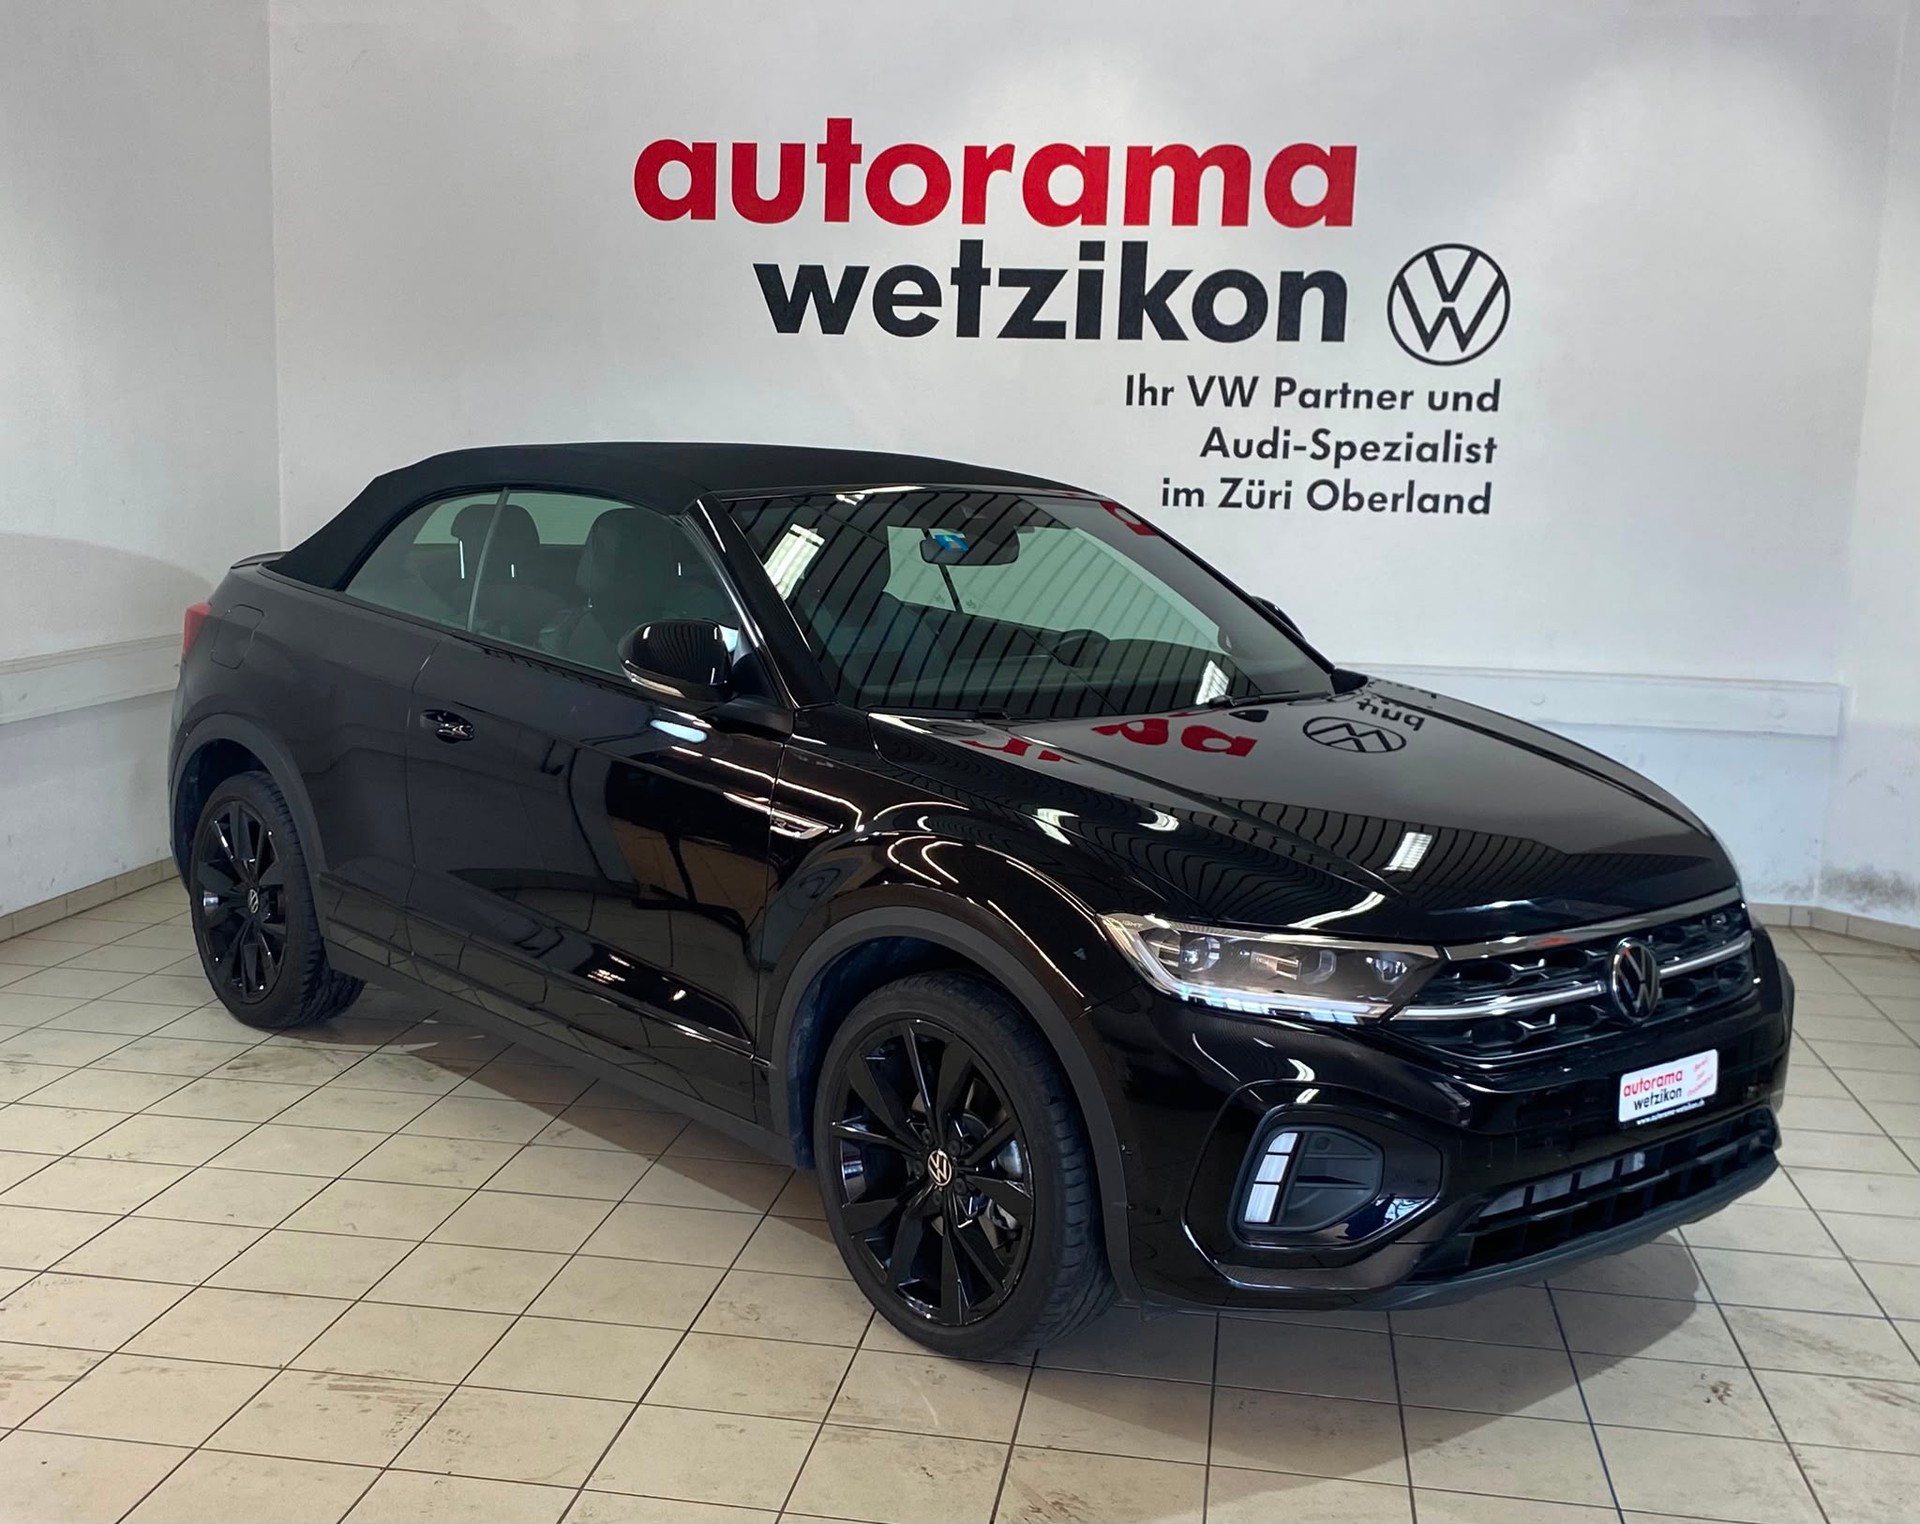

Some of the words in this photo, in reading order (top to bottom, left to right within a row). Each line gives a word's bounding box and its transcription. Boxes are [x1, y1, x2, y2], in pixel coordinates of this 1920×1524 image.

[633, 117, 1357, 229] autorama
[752, 239, 1348, 344] wetzikon
[1125, 372, 1175, 407] Ihr
[1187, 375, 1259, 408] VW
[1274, 376, 1414, 411] Partner
[1428, 378, 1501, 412] und
[1200, 426, 1499, 469] Audi-Spezialist
[1162, 477, 1206, 508] im
[1217, 477, 1293, 512] Züri
[1306, 479, 1492, 515] Oberland
[1623, 1069, 1684, 1098] autorama
[1633, 1087, 1682, 1111] wetzikon
